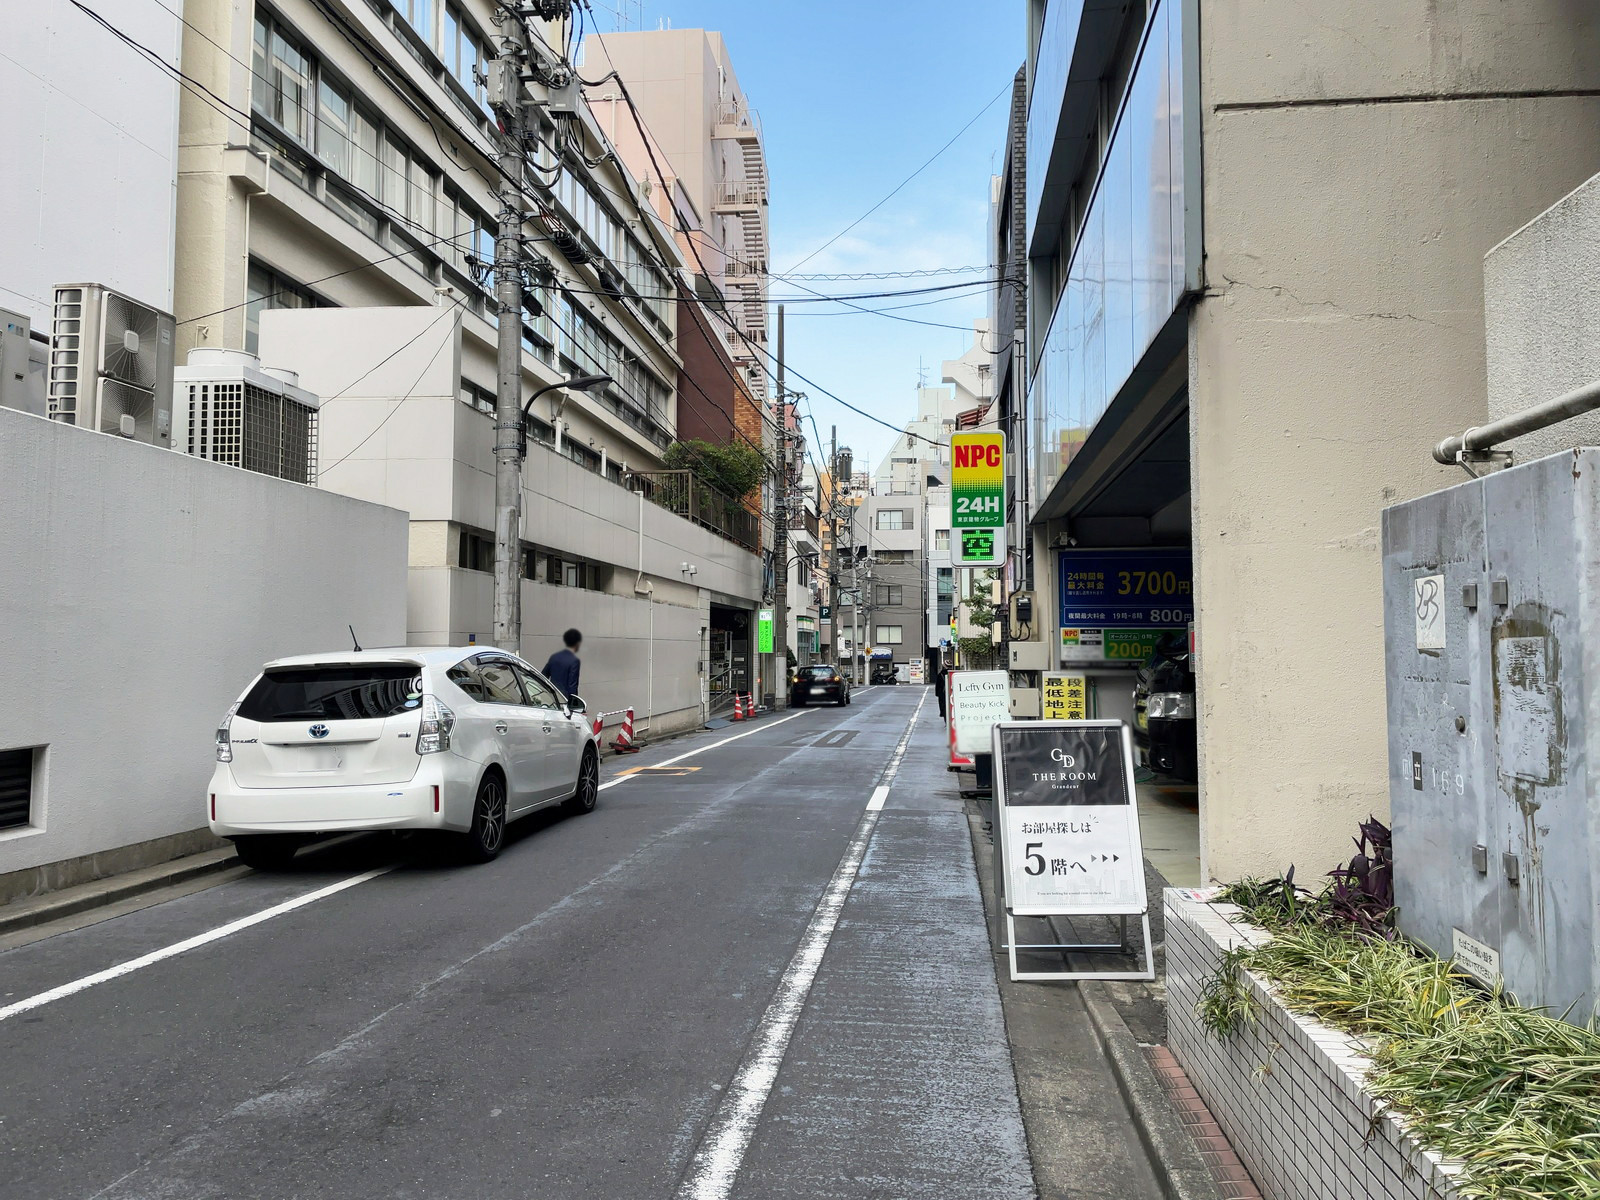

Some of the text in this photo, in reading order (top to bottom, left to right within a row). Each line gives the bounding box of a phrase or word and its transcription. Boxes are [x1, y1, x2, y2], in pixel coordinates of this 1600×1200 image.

[954, 444, 1001, 468] NPC
[956, 495, 1000, 514] 24H
[957, 515, 1000, 523] 東京建物グループ
[962, 529, 994, 561] 空
[1067, 581, 1105, 590] 最大料金
[1117, 570, 1190, 596] 3700円
[822, 608, 829, 616] P
[1068, 612, 1106, 620] 夜間最大料金
[1149, 609, 1193, 623] 800円
[1109, 641, 1153, 658] 200円
[982, 681, 1005, 693] Gym
[959, 700, 1005, 710] Beauty Kick
[1066, 677, 1083, 720] 段差注意
[1032, 772, 1097, 781] THE ROOM
[1021, 821, 1092, 835] お部屋探しは
[1023, 841, 1088, 877] 5階へ
